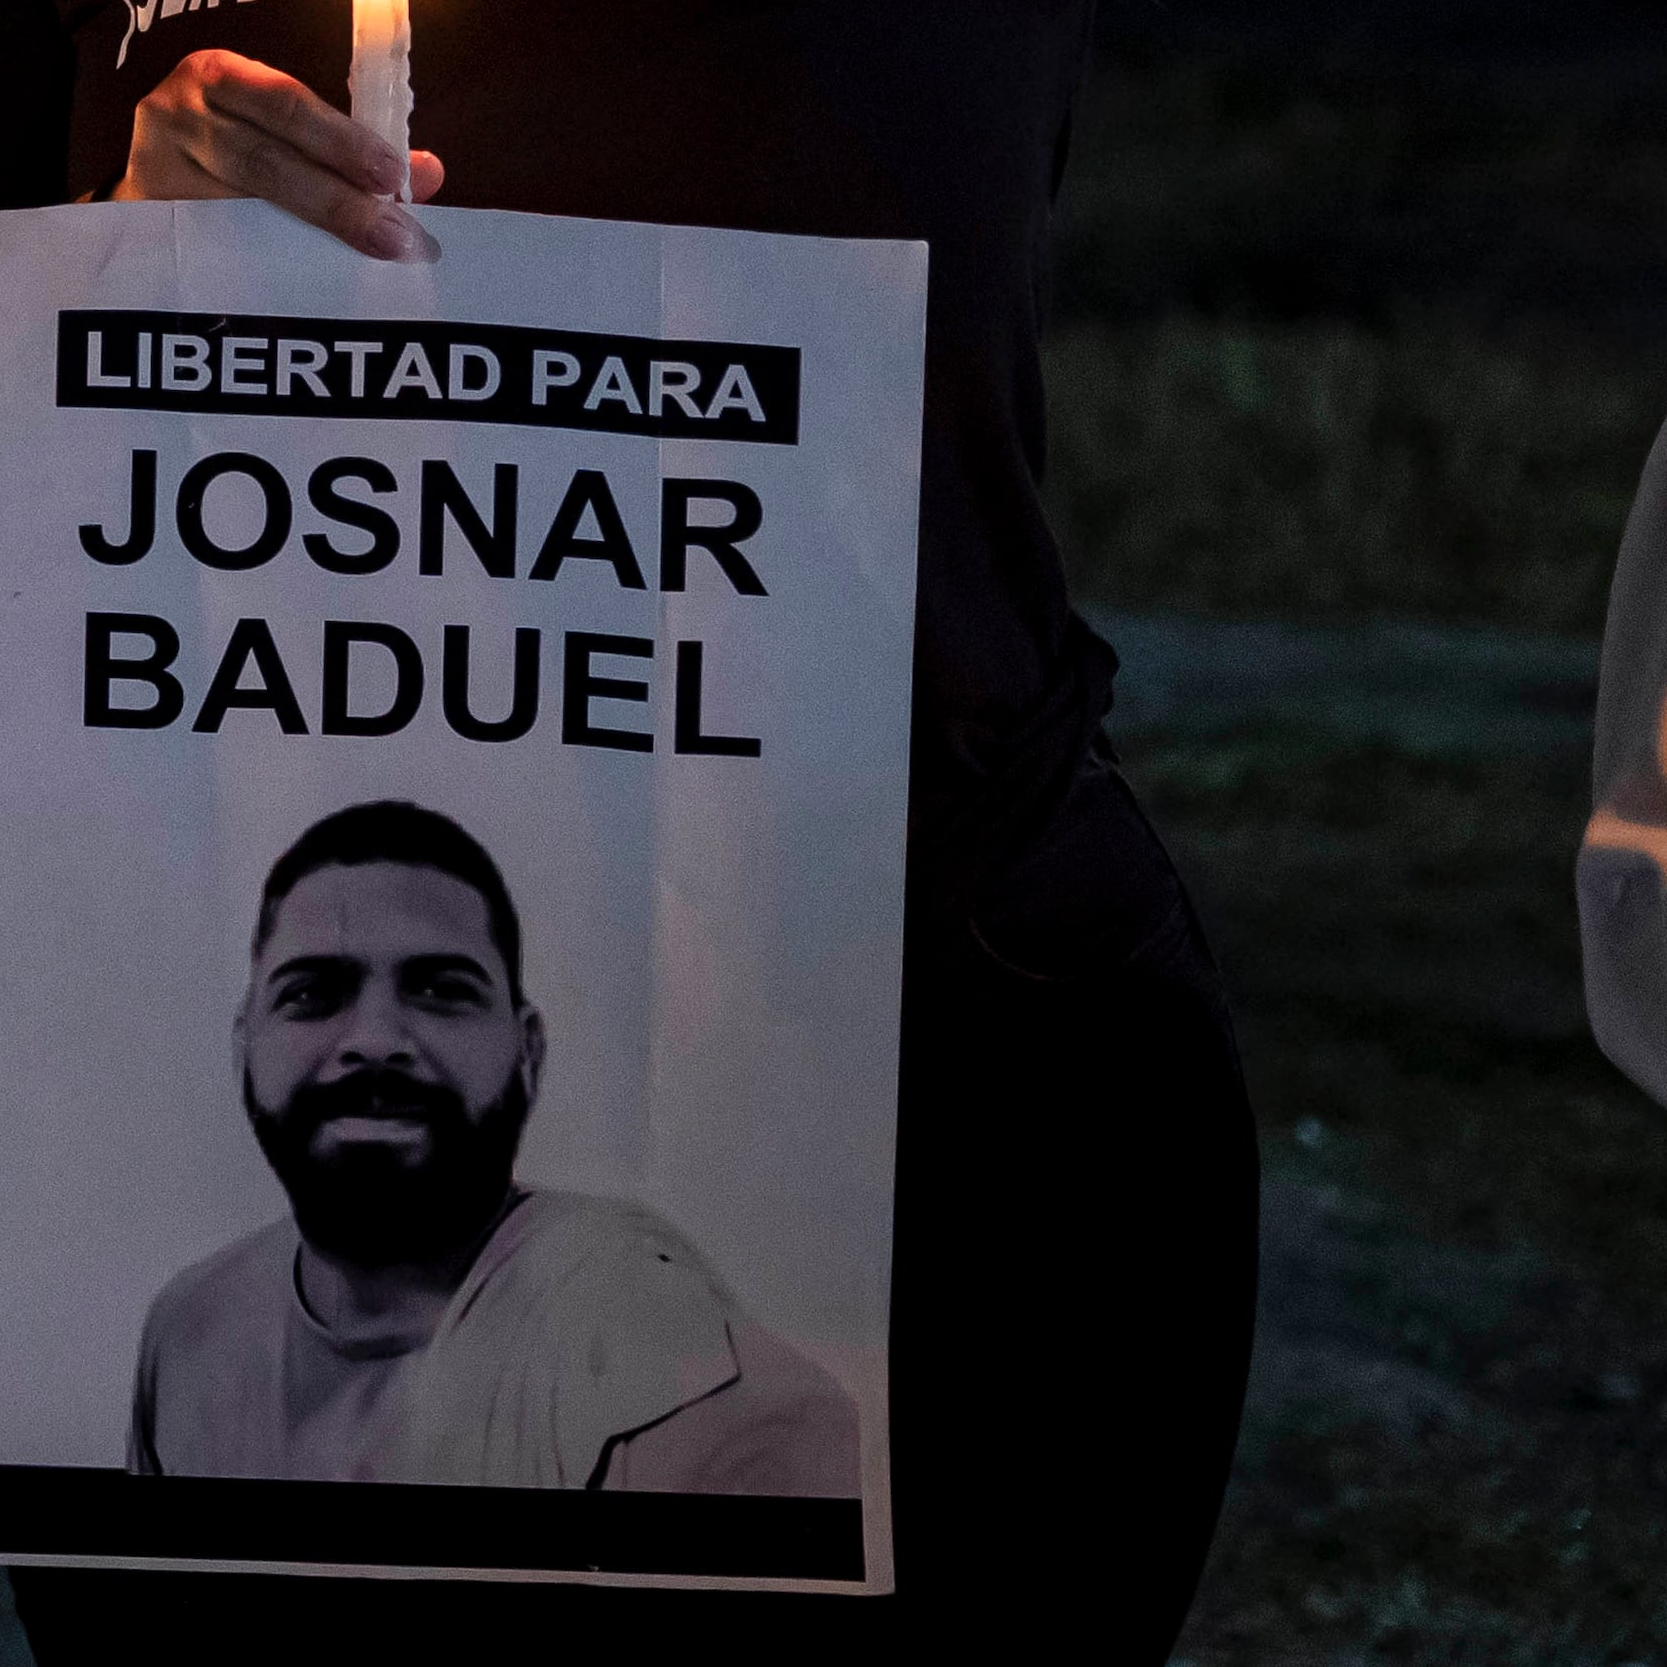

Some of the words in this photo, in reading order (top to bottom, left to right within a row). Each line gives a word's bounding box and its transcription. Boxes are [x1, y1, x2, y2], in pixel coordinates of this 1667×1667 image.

[85, 331, 502, 401] LIBERTAD
[531, 351, 767, 422] PARA
[78, 449, 770, 596] JOSNAR
[83, 611, 763, 758] BADUEL
